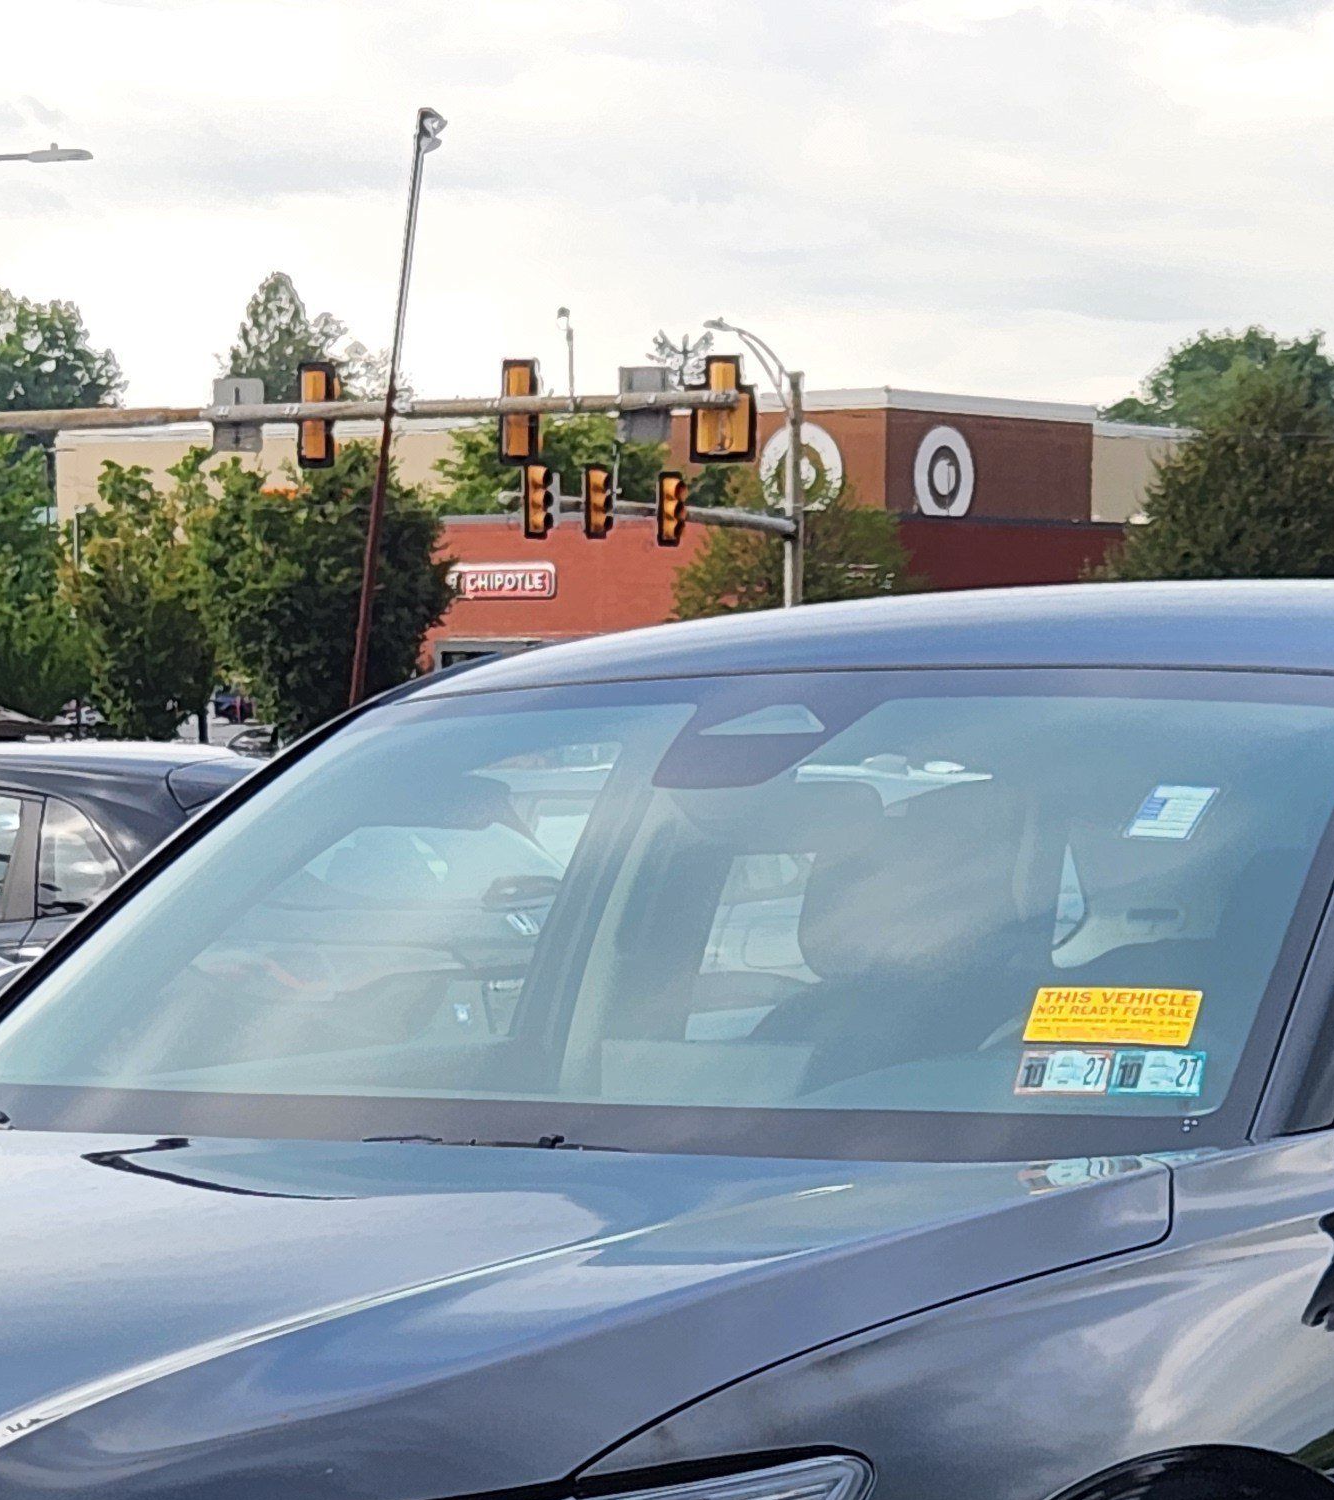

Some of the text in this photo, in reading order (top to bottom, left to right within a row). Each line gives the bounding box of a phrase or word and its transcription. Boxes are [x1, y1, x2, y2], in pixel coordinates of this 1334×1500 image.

[466, 572, 545, 591] CHIPOTLE
[1044, 991, 1197, 1007] THIS VEHICLE
[1035, 1005, 1194, 1019] NOT READY FOR SALE
[1082, 1056, 1107, 1087] 27
[1175, 1058, 1199, 1088] 27
